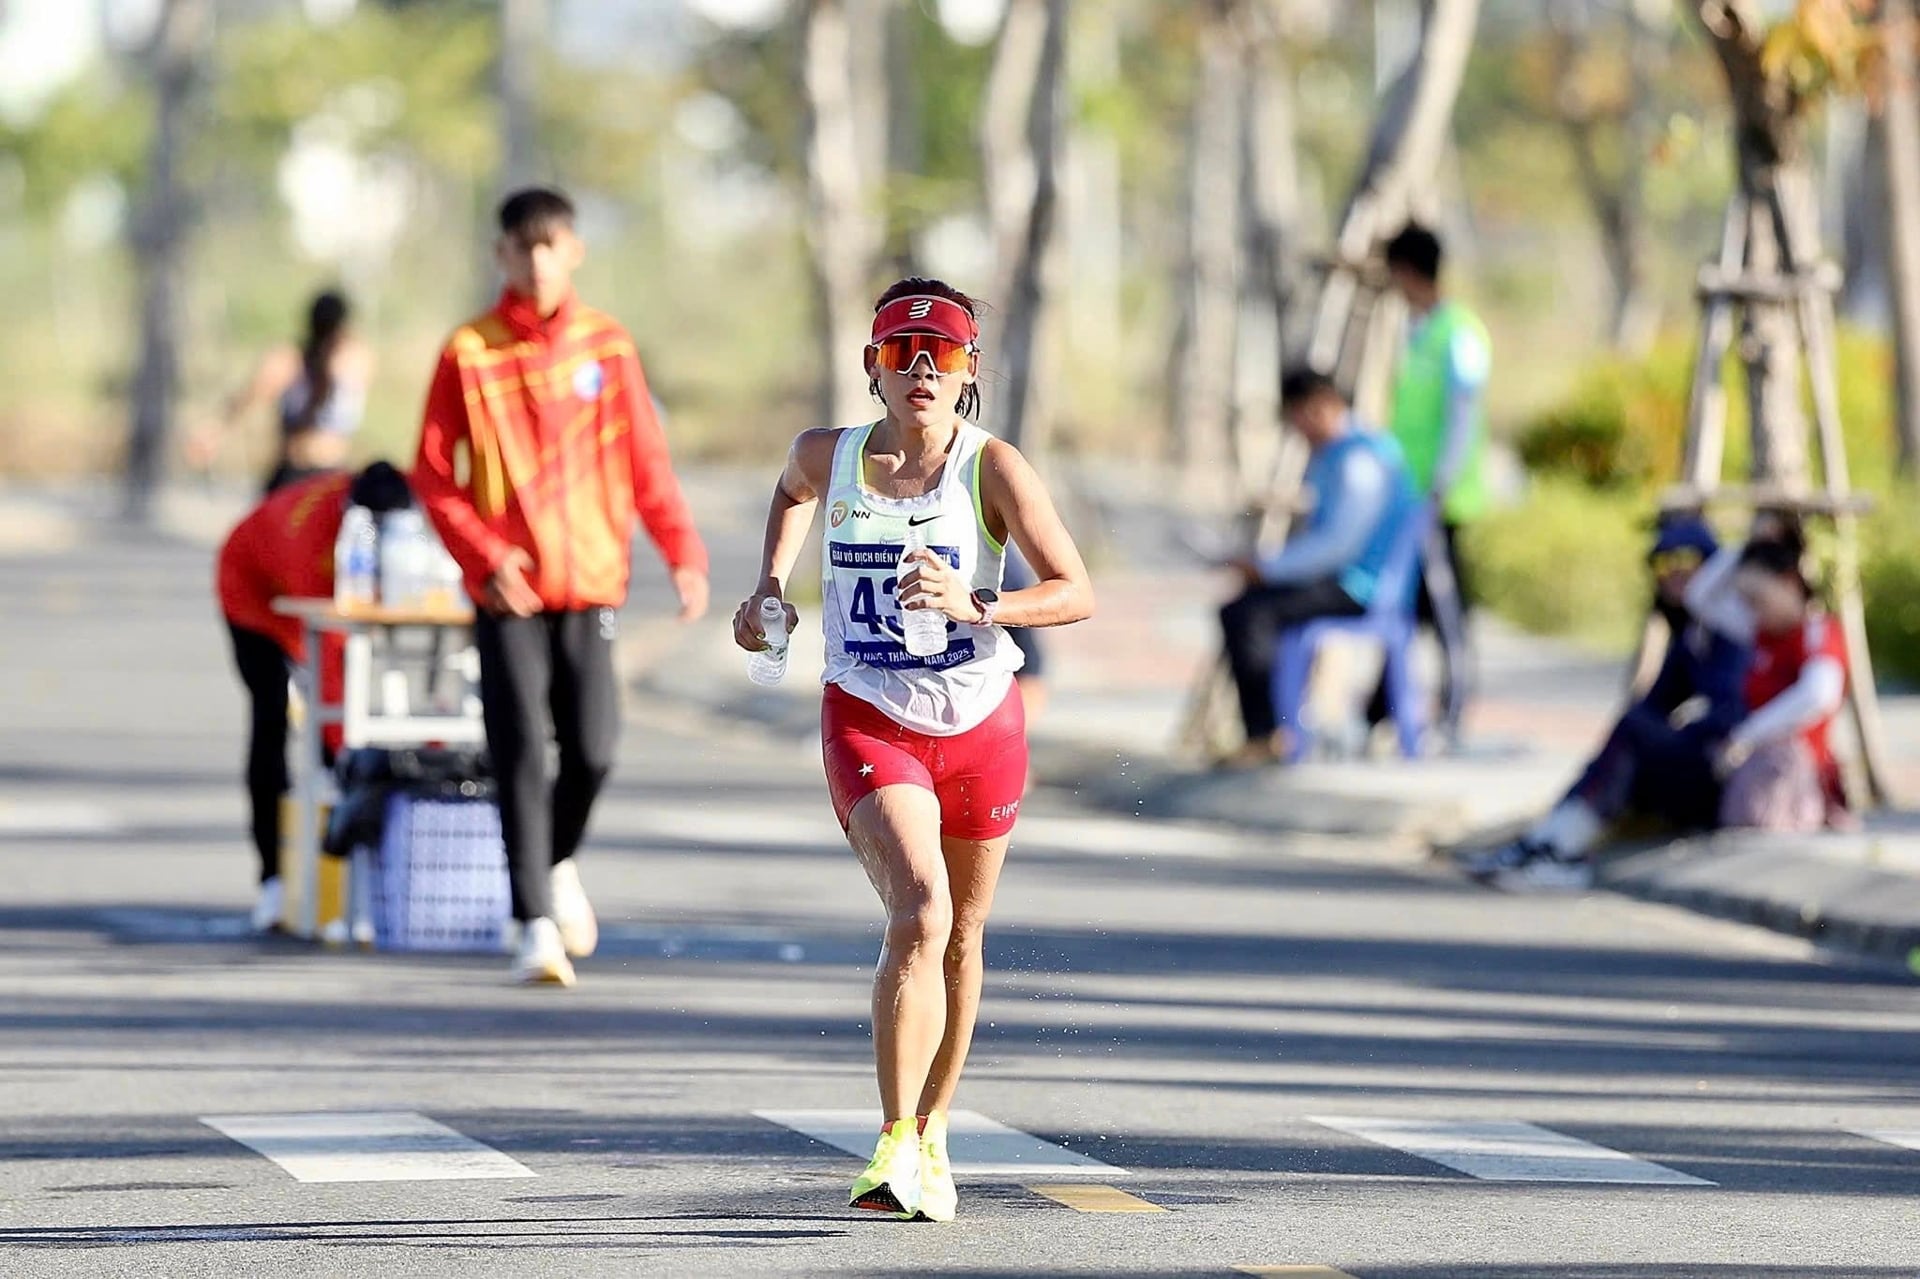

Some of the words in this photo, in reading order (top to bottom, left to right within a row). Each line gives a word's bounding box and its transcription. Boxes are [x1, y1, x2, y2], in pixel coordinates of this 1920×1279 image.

[850, 508, 871, 519] NN
[850, 576, 957, 636] 43
[947, 648, 970, 663] 2025
